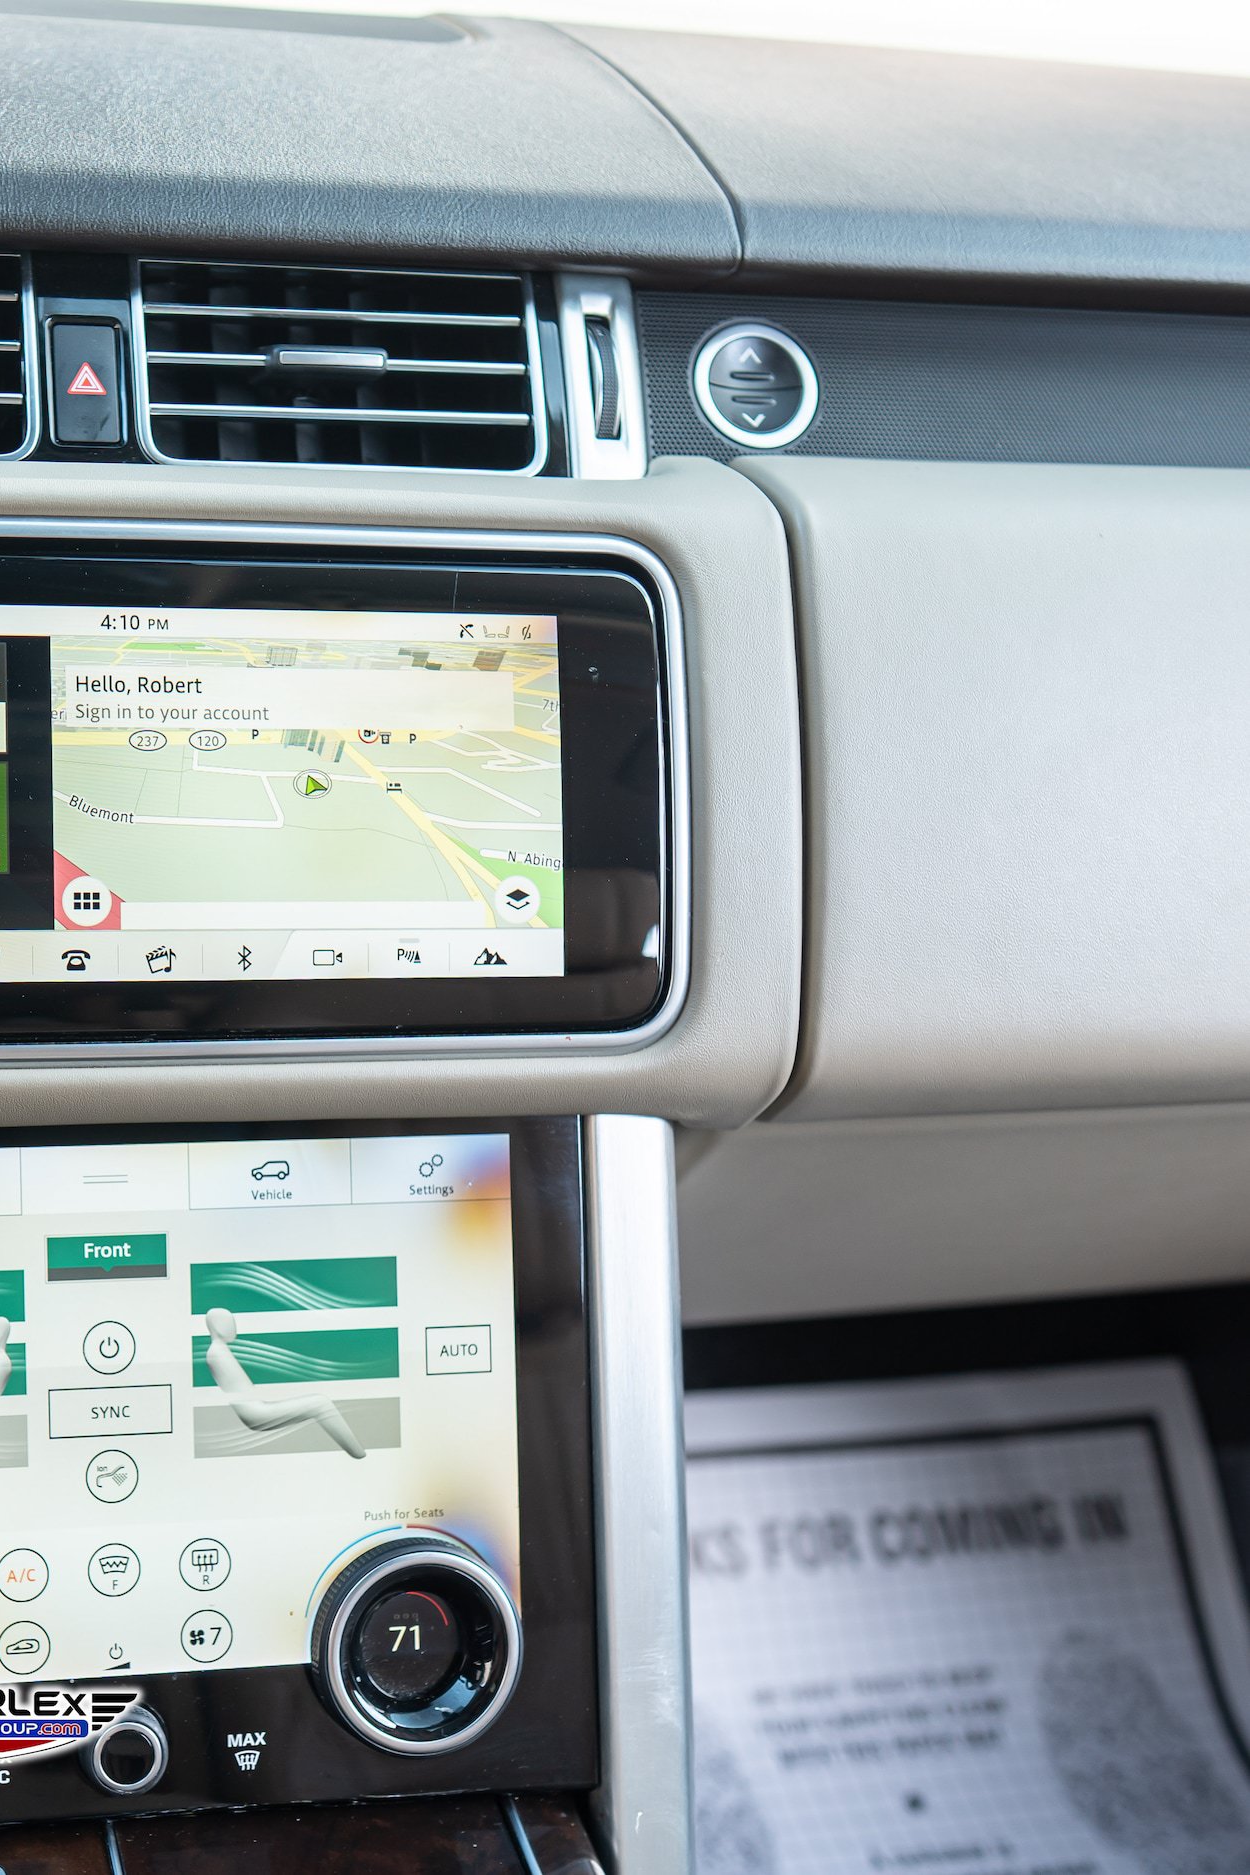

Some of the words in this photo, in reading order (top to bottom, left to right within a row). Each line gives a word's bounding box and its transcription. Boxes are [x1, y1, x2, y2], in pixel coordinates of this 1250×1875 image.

[100, 614, 140, 631] 4:10
[148, 618, 169, 631] PM
[75, 675, 131, 696] Hello,
[138, 676, 203, 694] Robert
[75, 703, 111, 723] Sign
[117, 704, 132, 720] in
[138, 706, 155, 720] to
[161, 708, 198, 724] your
[203, 706, 270, 721] account
[136, 735, 159, 747] 237
[197, 735, 220, 748] 120
[68, 794, 135, 825] Bluemont
[507, 850, 517, 863] N
[251, 1188, 293, 1201] Vehicle
[409, 1183, 455, 1197] Settings
[84, 1242, 131, 1259] Front
[439, 1343, 479, 1357] AUTO
[91, 1405, 131, 1420] SYNC
[364, 1510, 391, 1521] Push
[394, 1509, 410, 1520] for
[414, 1507, 445, 1519] Seats
[762, 1508, 858, 1572] FOR
[869, 1495, 1066, 1569] COMING
[1073, 1493, 1129, 1544] IN
[6, 1568, 37, 1584] A/C
[202, 1575, 210, 1585] R
[112, 1579, 118, 1590] F
[210, 1627, 222, 1645] 7
[388, 1624, 421, 1653] 71
[227, 1732, 267, 1748] MAX
